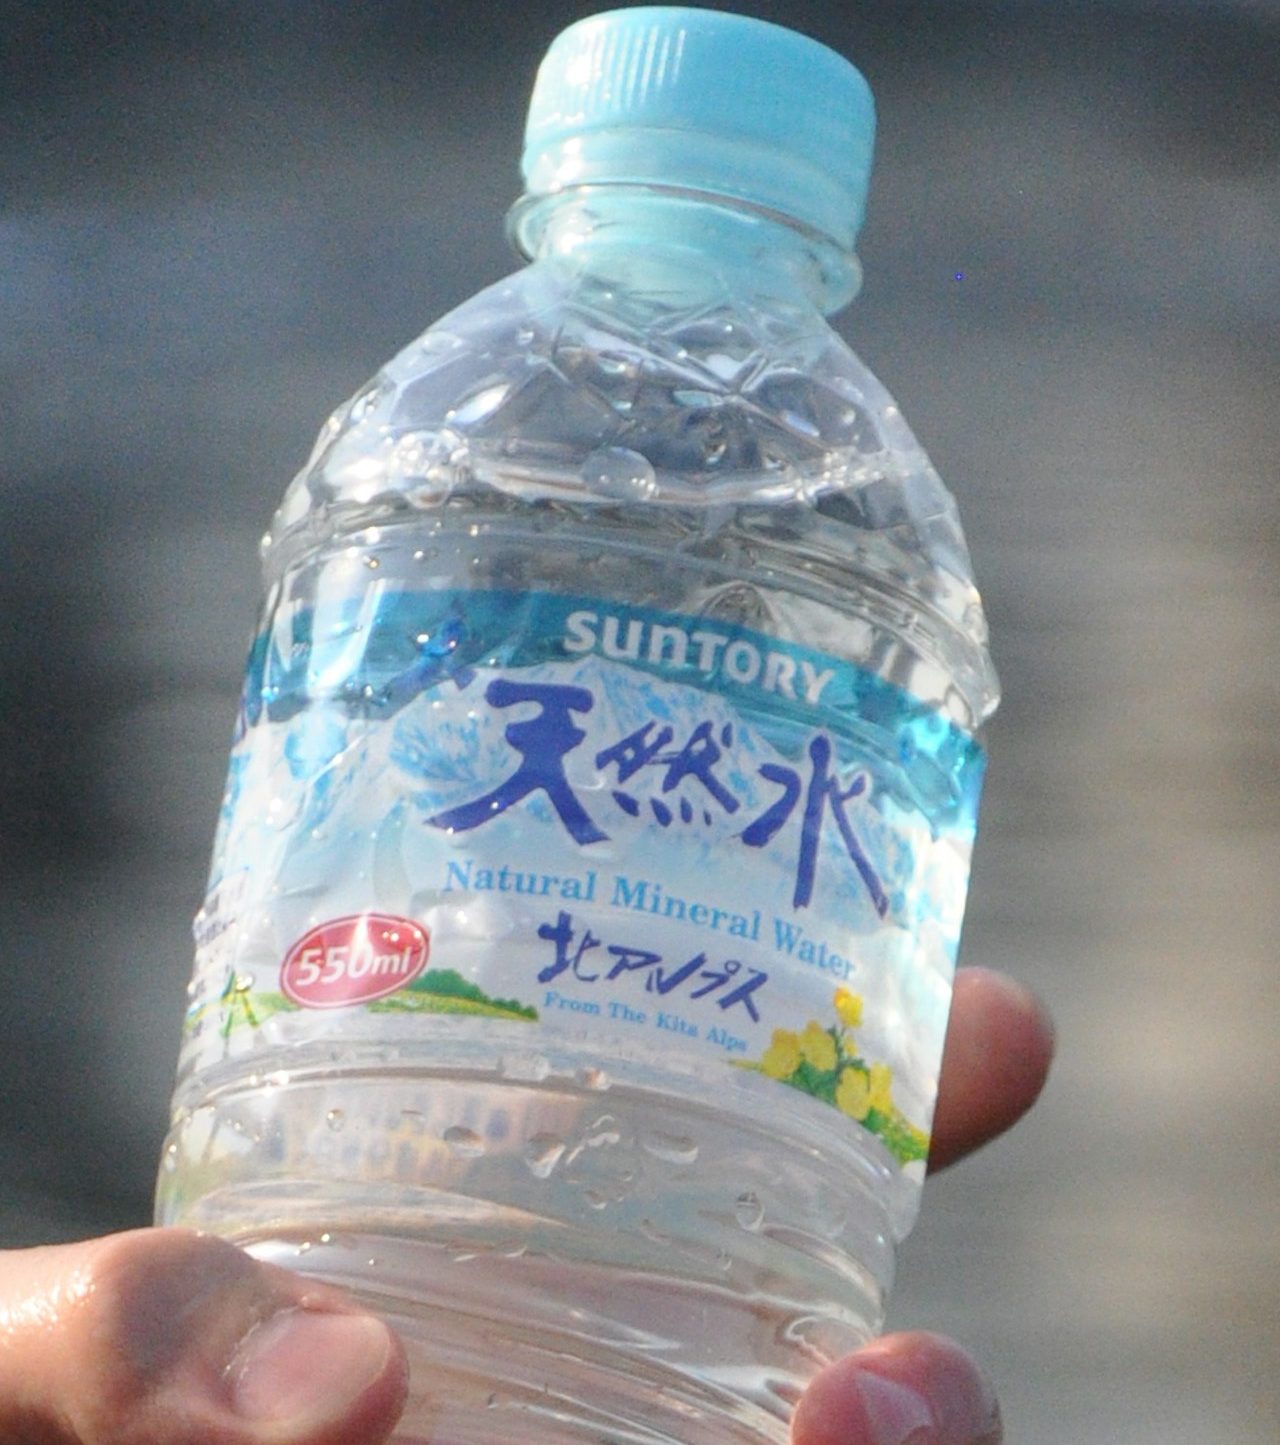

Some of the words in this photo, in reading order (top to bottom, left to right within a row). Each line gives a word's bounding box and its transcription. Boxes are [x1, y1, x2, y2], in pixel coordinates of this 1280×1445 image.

[423, 678, 889, 920] 天然水
[295, 941, 413, 987] 550ml
[443, 860, 597, 902] Natural
[610, 874, 762, 942] Mineral
[772, 916, 857, 982] Water
[537, 909, 768, 1024] 北アルプス
[543, 990, 601, 1015] From
[608, 1001, 647, 1025] The
[706, 1024, 748, 1052] Alps
